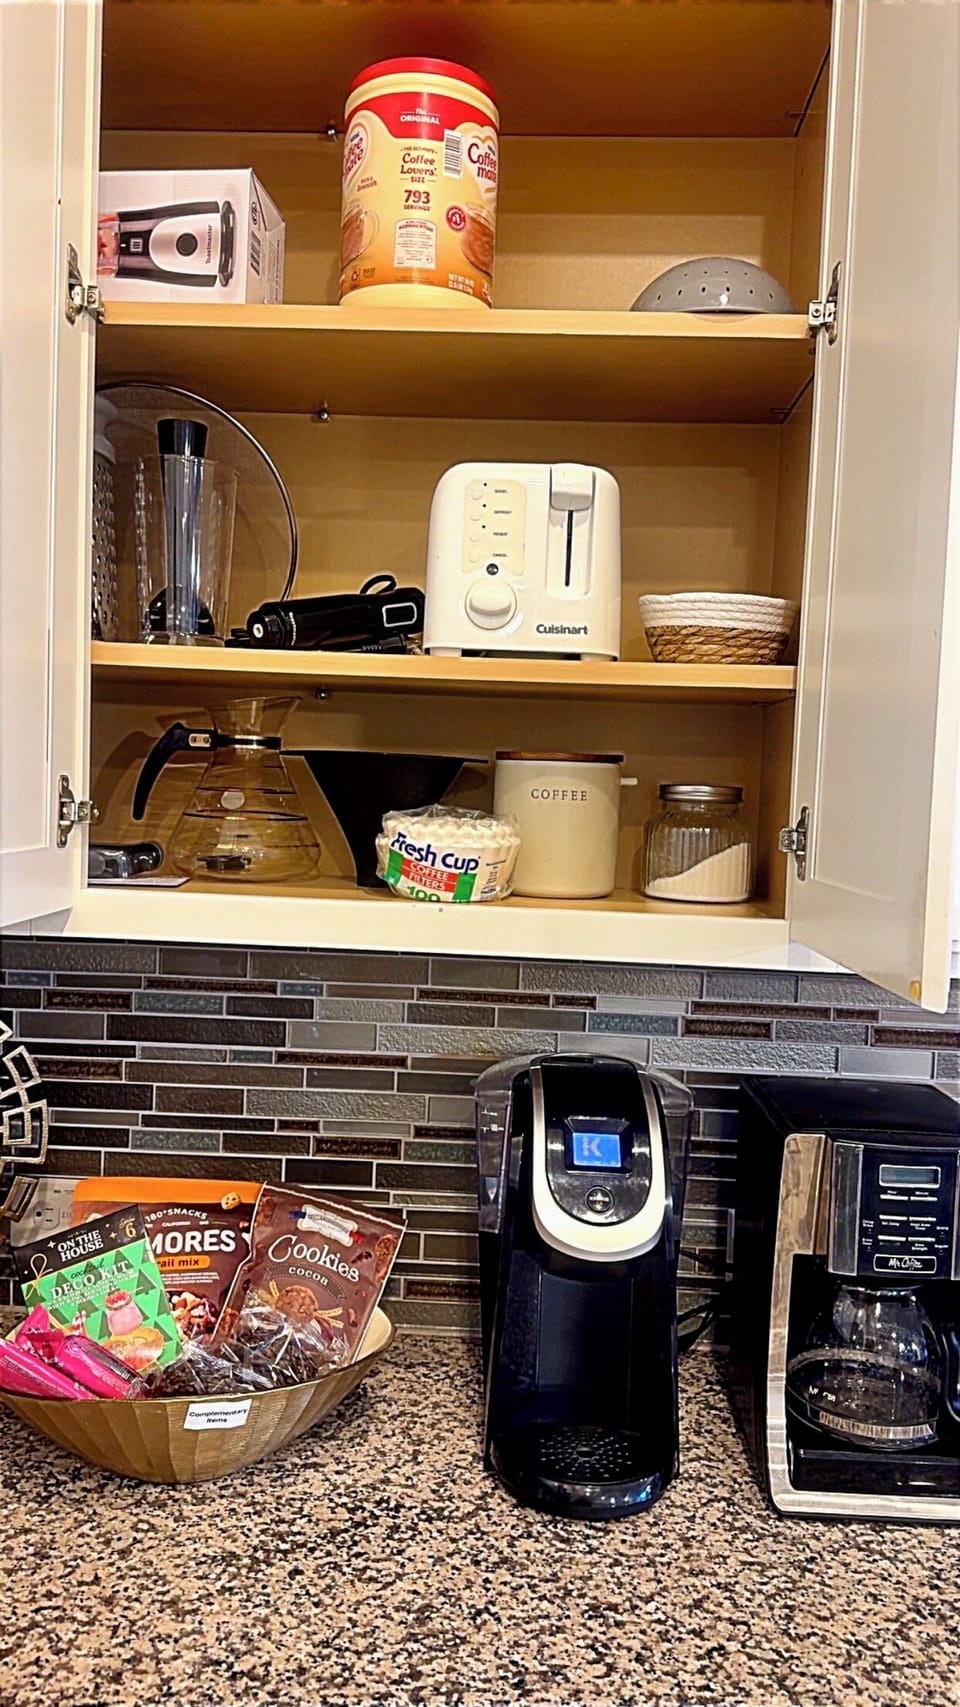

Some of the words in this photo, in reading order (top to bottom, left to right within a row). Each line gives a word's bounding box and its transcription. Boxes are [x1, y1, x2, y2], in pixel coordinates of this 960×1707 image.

[400, 115, 441, 125] ORIGINAL
[402, 152, 436, 166] Coffee
[404, 189, 431, 204] 793
[205, 224, 213, 265] Toastmaster
[536, 624, 588, 636] Cuisinart
[530, 788, 588, 802] COFFEE
[390, 831, 438, 867] Fresh
[441, 853, 480, 875] Cup
[408, 870, 446, 890] FILTERS
[410, 862, 449, 881] COFFEE
[125, 1222, 137, 1238] 6
[57, 1239, 76, 1252] ON
[75, 1229, 102, 1246] THE
[60, 1238, 104, 1262] HOUSE
[178, 1258, 200, 1267] mix
[268, 1234, 359, 1282] Cookies
[51, 1274, 96, 1299] DECO
[100, 1260, 129, 1281] KIT
[288, 1266, 329, 1286] cocoa
[189, 1408, 247, 1417] Complementary
